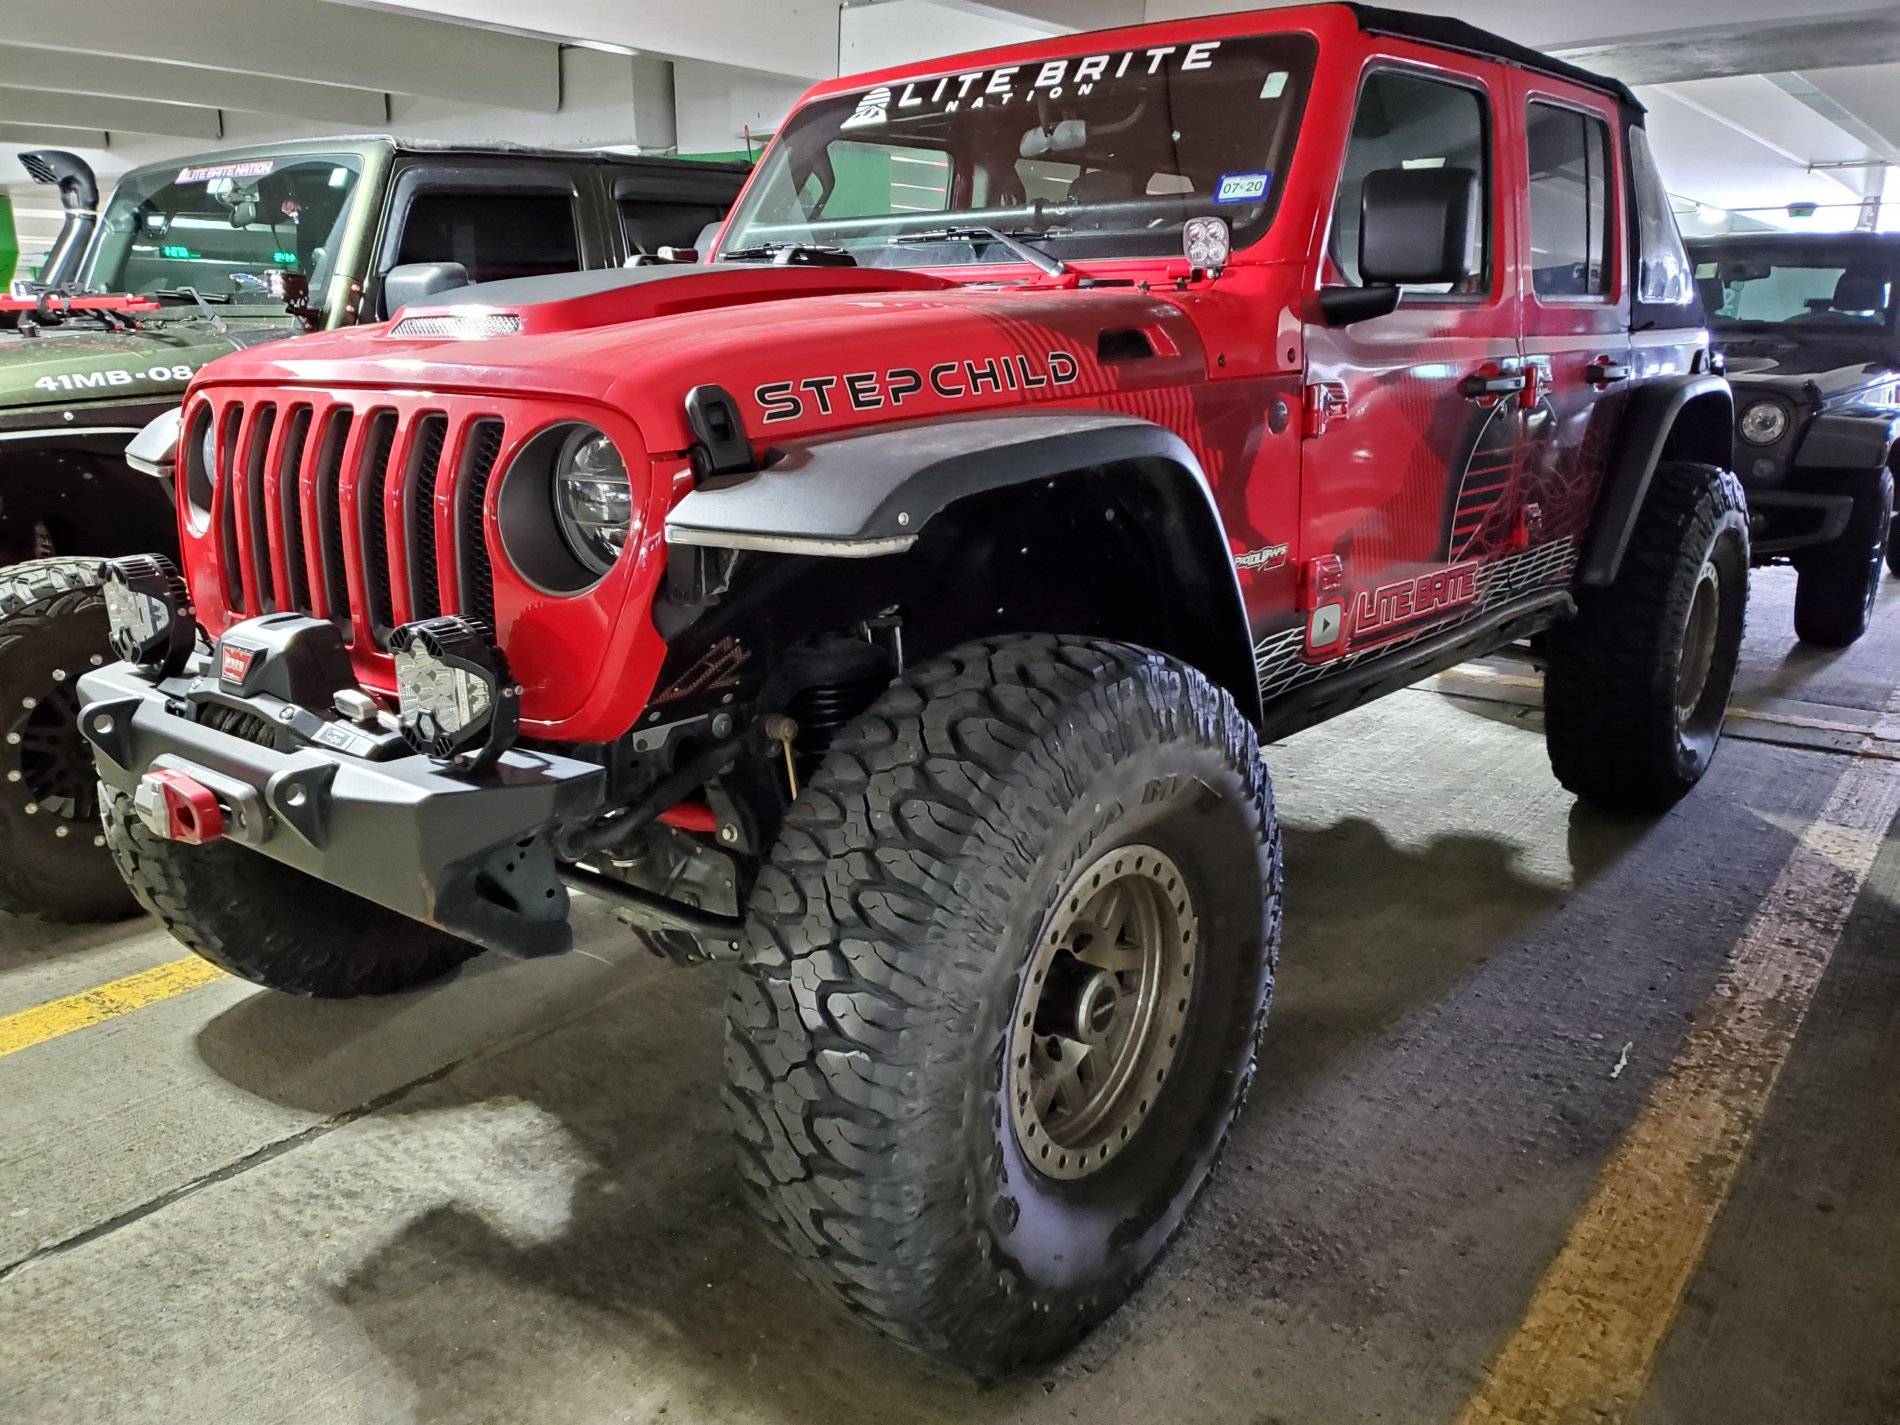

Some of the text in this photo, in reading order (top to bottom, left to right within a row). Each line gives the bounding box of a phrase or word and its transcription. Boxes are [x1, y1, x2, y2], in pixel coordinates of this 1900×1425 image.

[899, 41, 1221, 107] LITE BRITE
[944, 83, 1094, 112] NATION
[754, 351, 1078, 424] STEPCHILD
[1356, 561, 1478, 633] LITE BRITE
